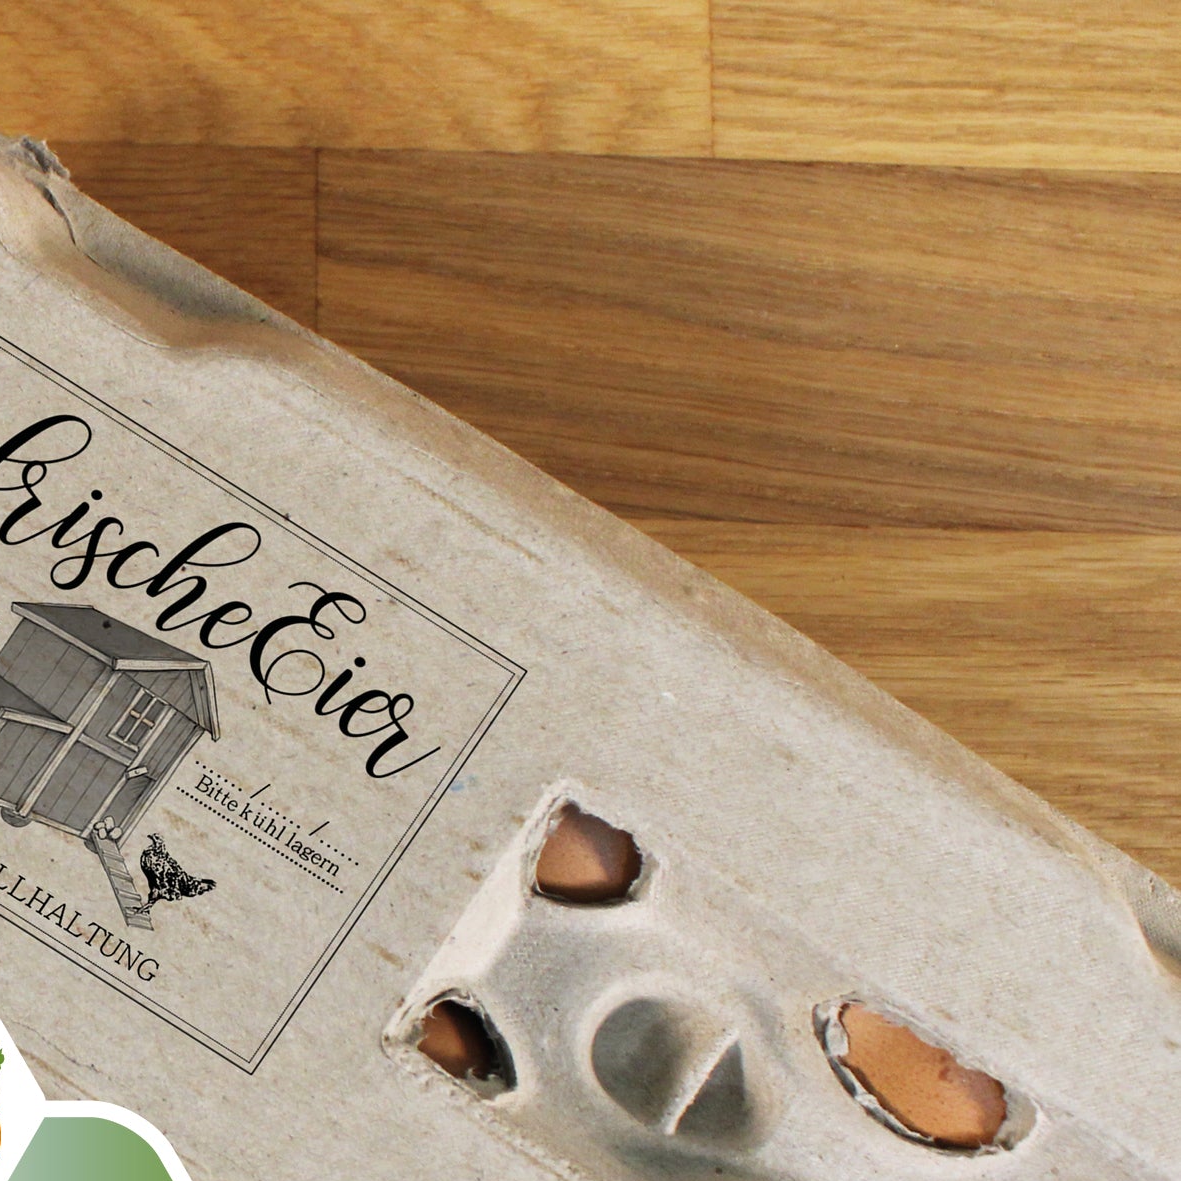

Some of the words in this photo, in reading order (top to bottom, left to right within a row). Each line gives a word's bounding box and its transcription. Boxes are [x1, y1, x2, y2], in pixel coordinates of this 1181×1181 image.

[249, 580, 441, 779] Eier
[194, 773, 239, 812] Bitte
[238, 802, 287, 841] kühl
[284, 832, 340, 877] lagern
